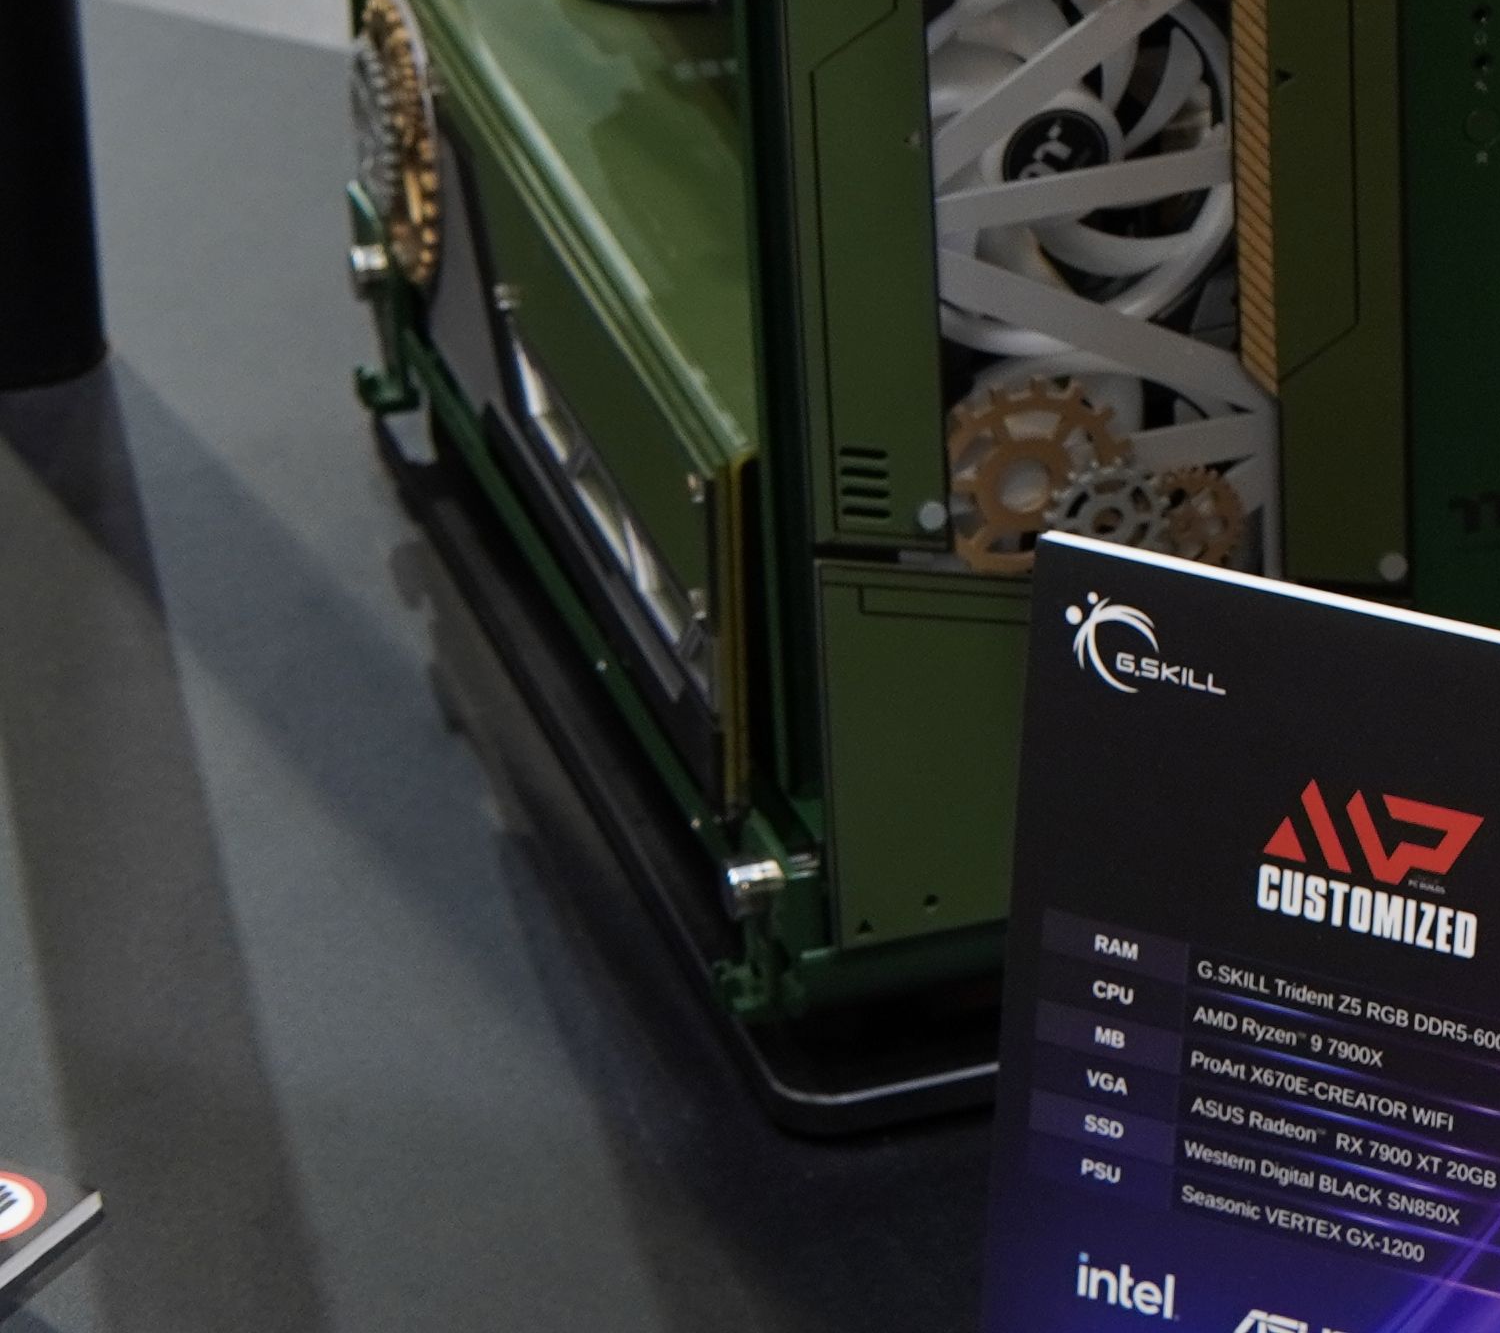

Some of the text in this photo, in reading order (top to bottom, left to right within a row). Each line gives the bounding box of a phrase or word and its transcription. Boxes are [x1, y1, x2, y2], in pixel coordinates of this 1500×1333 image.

[1116, 652, 1226, 696] G.SKILL
[1257, 864, 1478, 959] CUSTOMIZED
[1094, 933, 1139, 961] RAM
[1092, 980, 1135, 1005] CPU
[1197, 960, 1270, 994] G.SKILL
[1274, 978, 1334, 1010] Trident
[1337, 994, 1362, 1017] Z5
[1366, 1002, 1409, 1028] RGB
[1094, 1026, 1126, 1049] MB
[1193, 1006, 1238, 1031] AMD
[1310, 1036, 1323, 1052] 9
[1327, 1038, 1383, 1068] 7900X
[1086, 1069, 1128, 1095] VGA
[1190, 1050, 1454, 1132] ProArt X670E-CREATOR WIFI
[1084, 1114, 1124, 1139] SSD
[1191, 1097, 1245, 1125] ASUS
[1336, 1133, 1364, 1156] RX
[1369, 1141, 1412, 1168] 7900
[1416, 1154, 1443, 1175] XT
[1446, 1161, 1497, 1190] 20GB
[1081, 1158, 1122, 1184] PSU
[1184, 1140, 1460, 1226] Western Digital BLACK SN850X
[1181, 1185, 1425, 1263] Seasonic VERTEX GX-1200
[1077, 1251, 1176, 1320] intel
